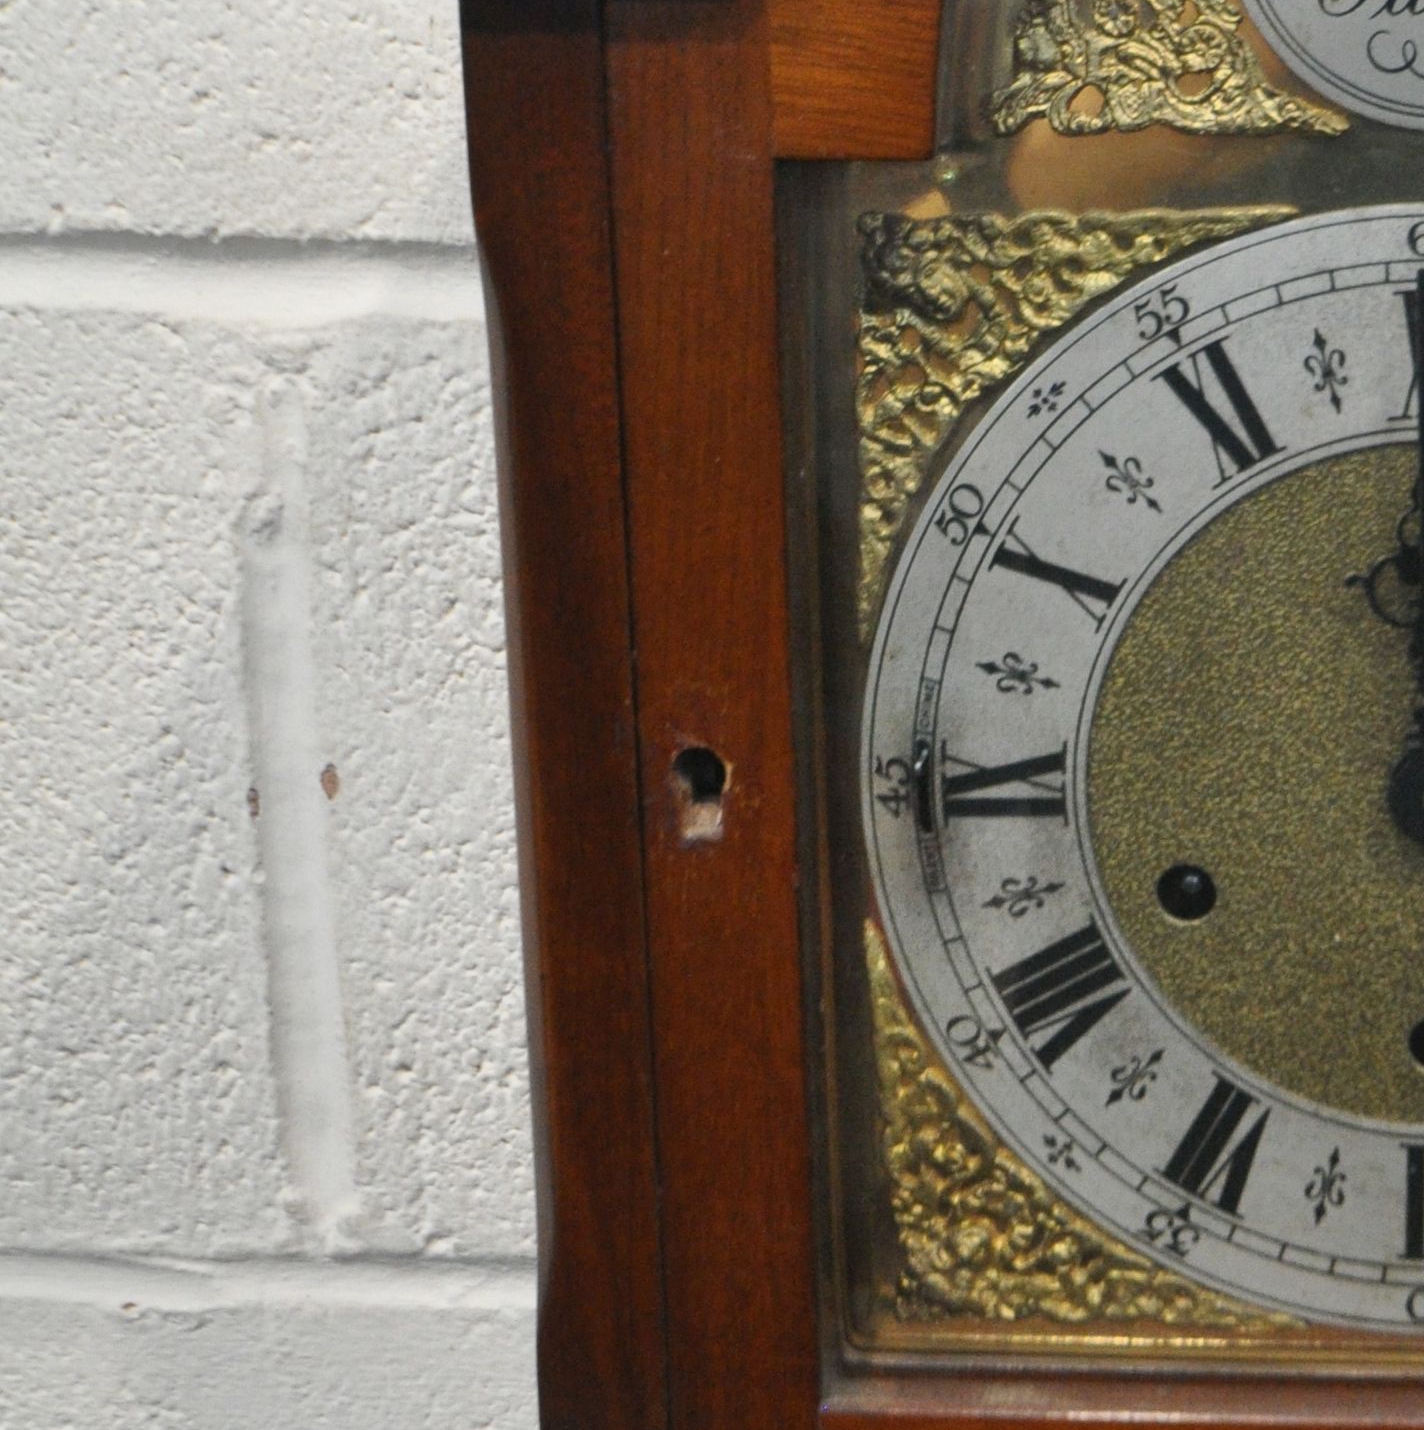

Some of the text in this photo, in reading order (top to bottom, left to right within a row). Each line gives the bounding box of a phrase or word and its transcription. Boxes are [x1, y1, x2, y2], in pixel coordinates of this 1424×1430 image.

[1133, 284, 1190, 340] 55
[1152, 336, 1287, 490] XI
[934, 482, 986, 547] 50
[988, 515, 1129, 632] X
[875, 754, 911, 819] 45
[940, 739, 1069, 828] IX
[985, 912, 1133, 1074] VIII
[945, 1013, 995, 1072] 40
[1153, 1071, 1273, 1220] VII
[1137, 1209, 1201, 1259] 35
